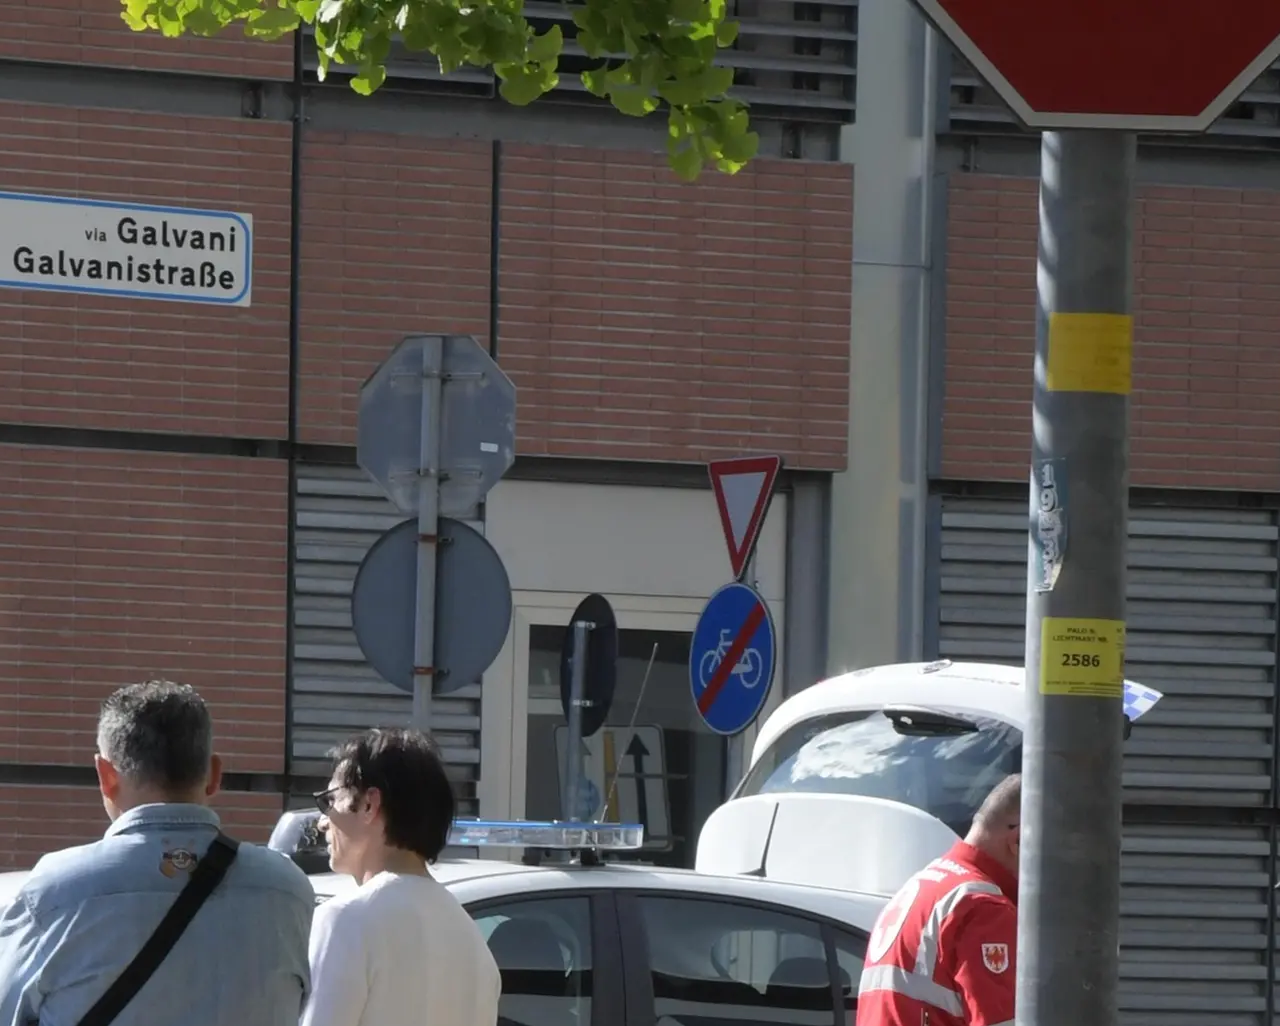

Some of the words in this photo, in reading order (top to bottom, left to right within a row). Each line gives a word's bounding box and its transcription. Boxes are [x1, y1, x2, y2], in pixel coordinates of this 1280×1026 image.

[84, 227, 107, 243] via
[117, 216, 237, 253] Galvani
[13, 246, 236, 290] Galvanistraße
[1061, 653, 1100, 668] 2586
